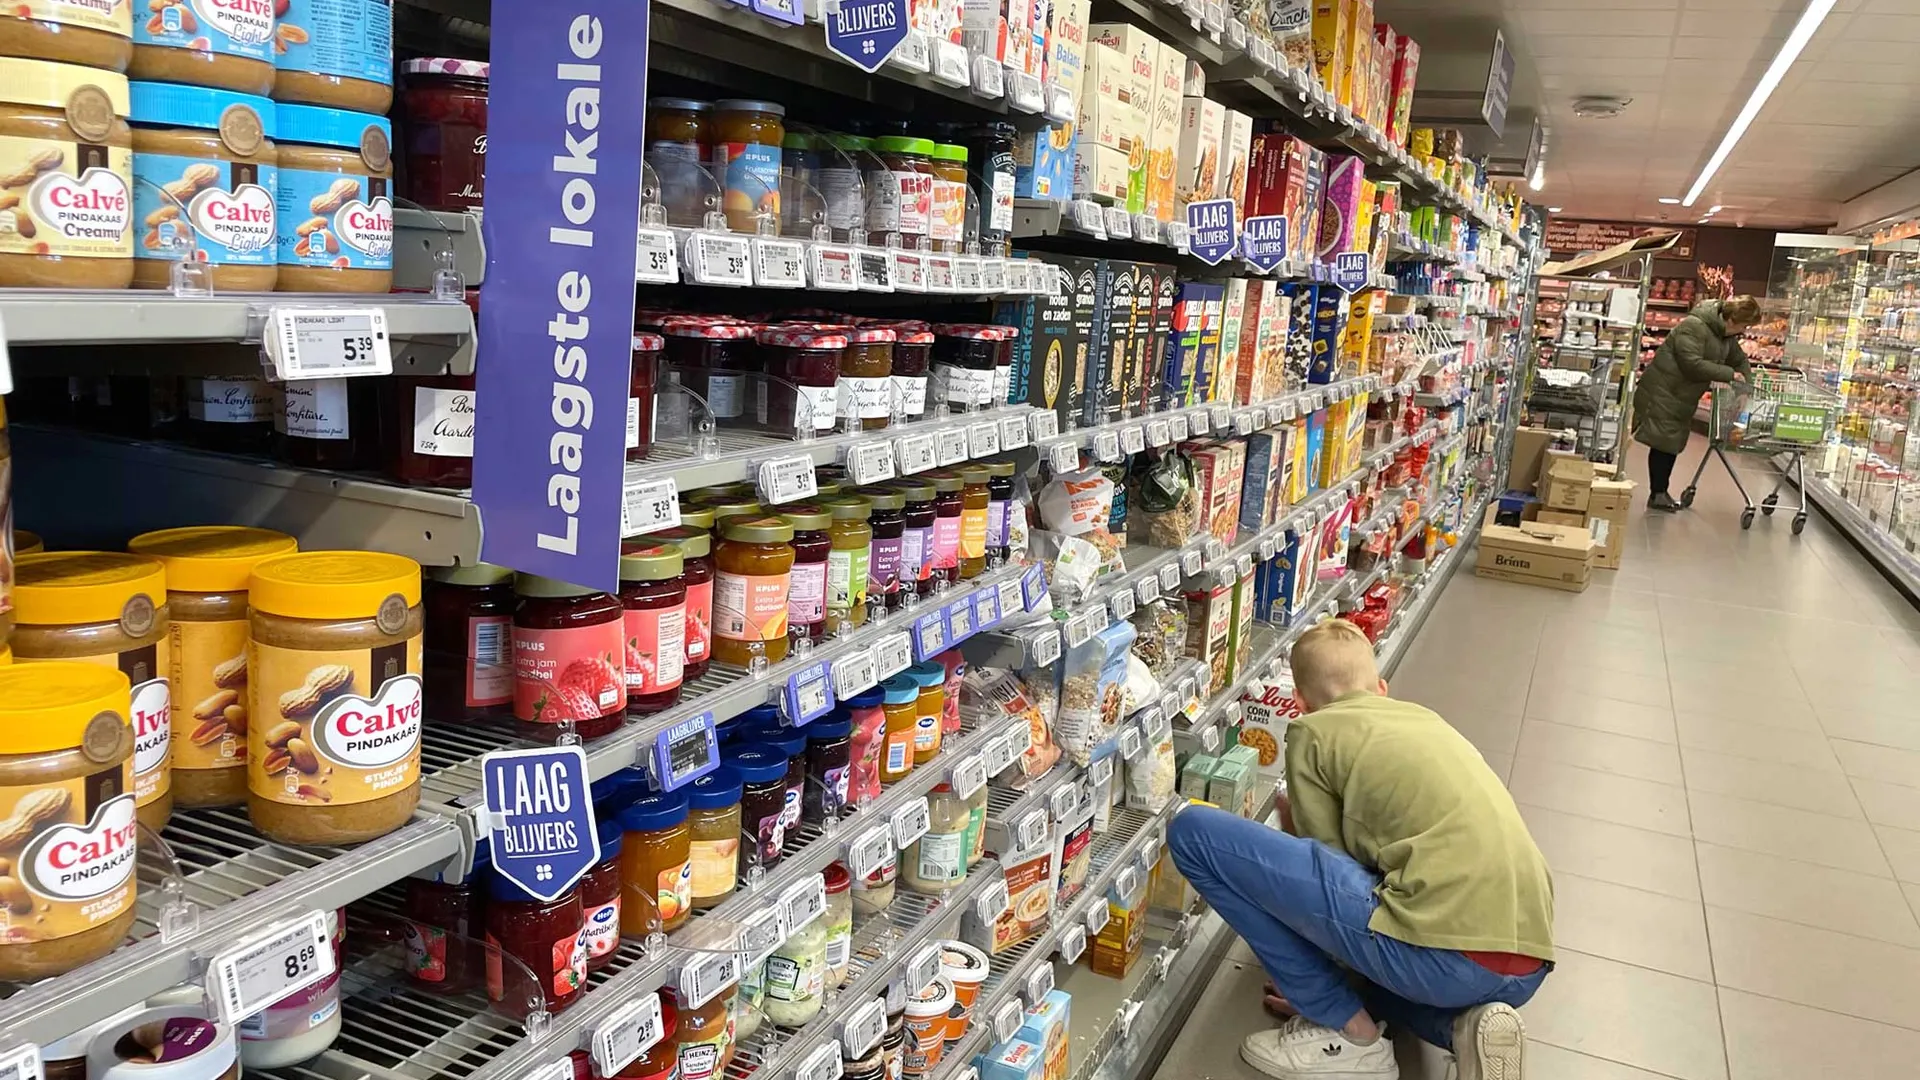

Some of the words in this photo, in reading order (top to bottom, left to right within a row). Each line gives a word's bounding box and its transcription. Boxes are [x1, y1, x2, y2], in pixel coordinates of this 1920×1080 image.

[217, 11, 268, 29] PINDAKAAS
[838, 3, 896, 34] BLIJVERS
[231, 23, 264, 45] Light
[550, 14, 603, 247] lokale
[49, 186, 125, 211] Calvé
[58, 211, 122, 223] PINDAKAAS
[207, 200, 271, 223] Calvé
[1193, 204, 1228, 230] LAAG
[64, 223, 121, 242] Creamy
[214, 223, 268, 234] PINDAKAAS
[355, 232, 391, 242] PINDAKAA
[1195, 230, 1229, 246] BLIJVERS
[1252, 220, 1281, 240] LAAG
[230, 232, 262, 251] Light
[1341, 255, 1364, 270] LAAG
[1053, 309, 1072, 321] zaden
[1101, 271, 1114, 346] packed
[452, 395, 474, 413] Bon
[537, 270, 594, 556] Laagste
[1789, 413, 1823, 425] PLUS
[1495, 554, 1530, 569] Brinta
[521, 641, 545, 652] PLUS
[537, 658, 557, 671] jam
[336, 690, 421, 737] Calvé
[1246, 714, 1270, 725] FLAKES
[1247, 705, 1270, 718] CORN
[346, 722, 417, 753] PINDAKAAS
[667, 716, 705, 741] LAAGBLIJVER
[135, 730, 168, 754] AKAAS
[363, 762, 409, 784] STUKJES
[373, 775, 404, 792] PINDA
[497, 761, 571, 816] LAAG
[47, 812, 136, 871] Calvé
[504, 820, 578, 853] BLIJVERS
[60, 846, 135, 886] PINDAKAAS
[80, 886, 128, 918] STUKJES
[89, 898, 124, 924] PINDA
[307, 988, 325, 1004] wit
[689, 1047, 711, 1059] HEINZ
[1005, 1042, 1029, 1065] Brinta
[684, 1058, 711, 1070] Sandwich
